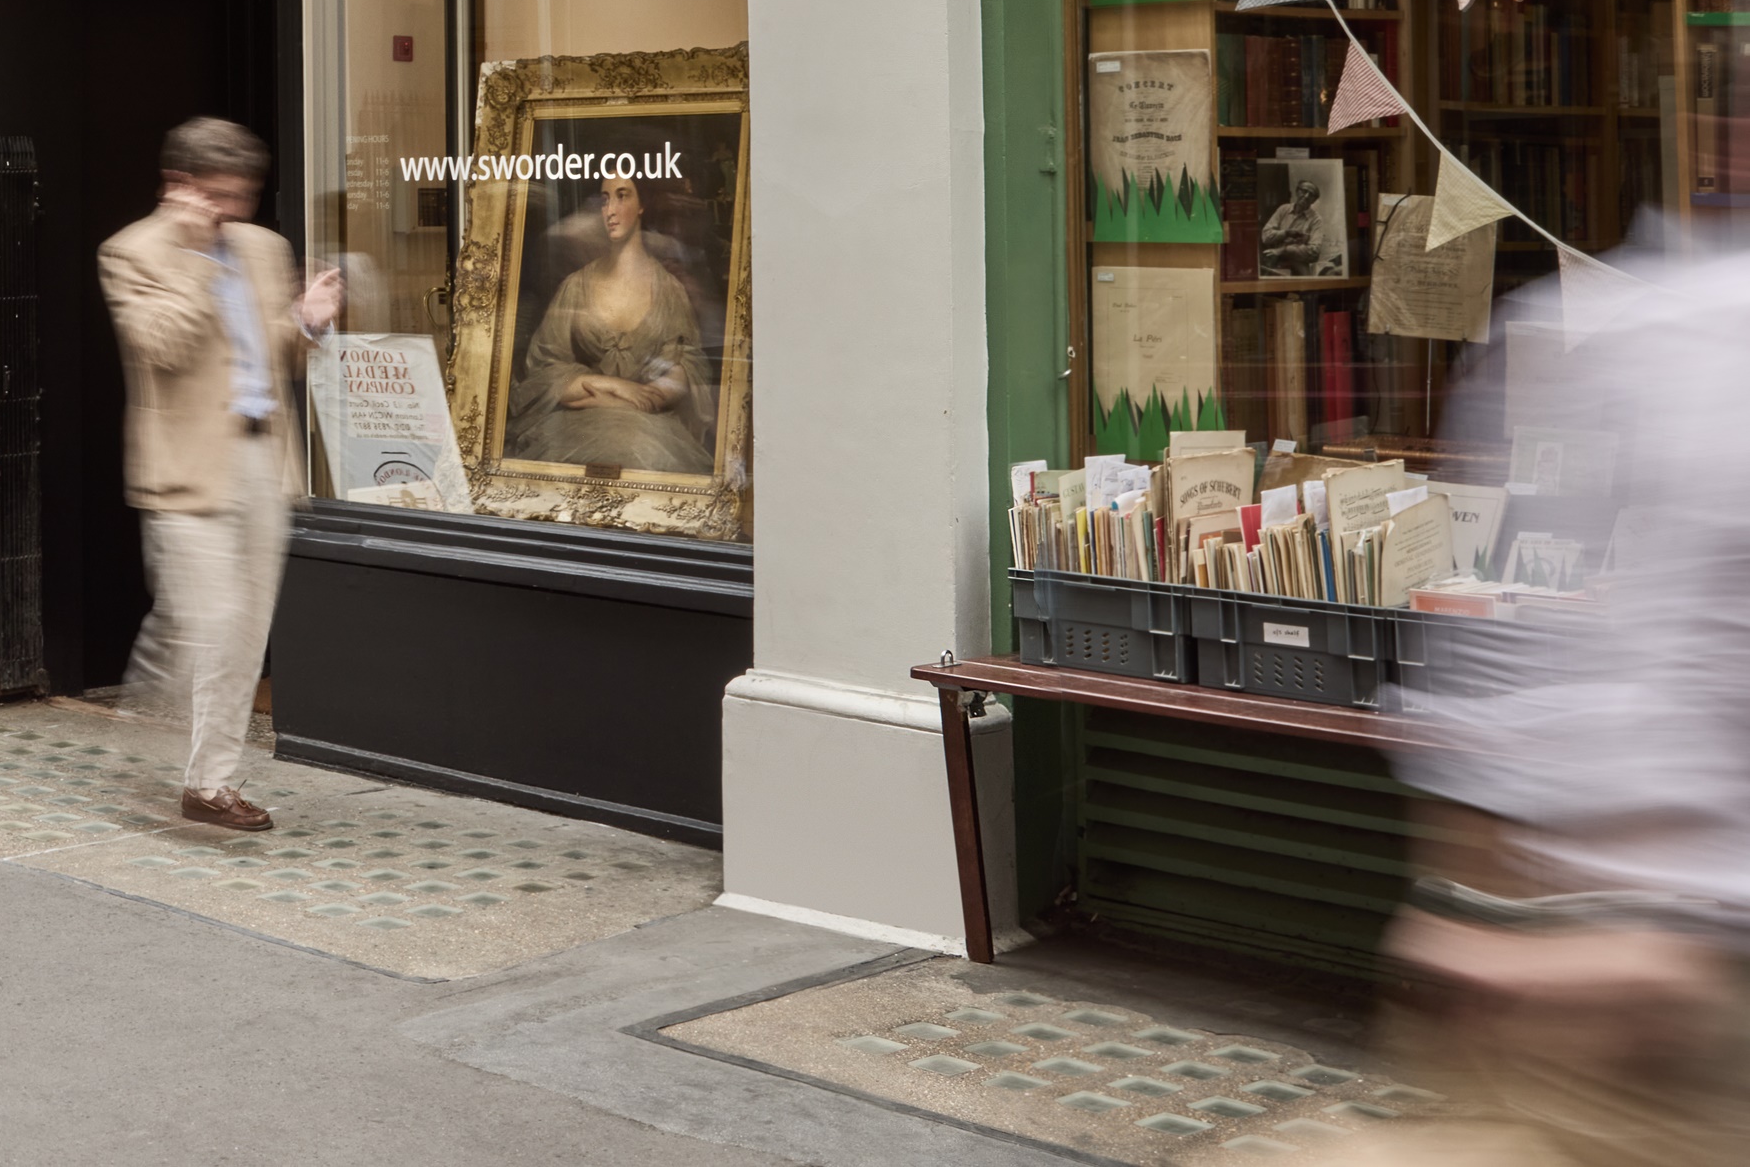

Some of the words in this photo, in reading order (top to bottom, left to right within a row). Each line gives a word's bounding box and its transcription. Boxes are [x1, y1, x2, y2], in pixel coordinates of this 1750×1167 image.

[346, 135, 368, 144] PENING
[400, 141, 682, 181] www.sworder.co.uk
[1133, 334, 1143, 342] La
[1179, 488, 1199, 508] SONGS
[1199, 483, 1208, 494] OF
